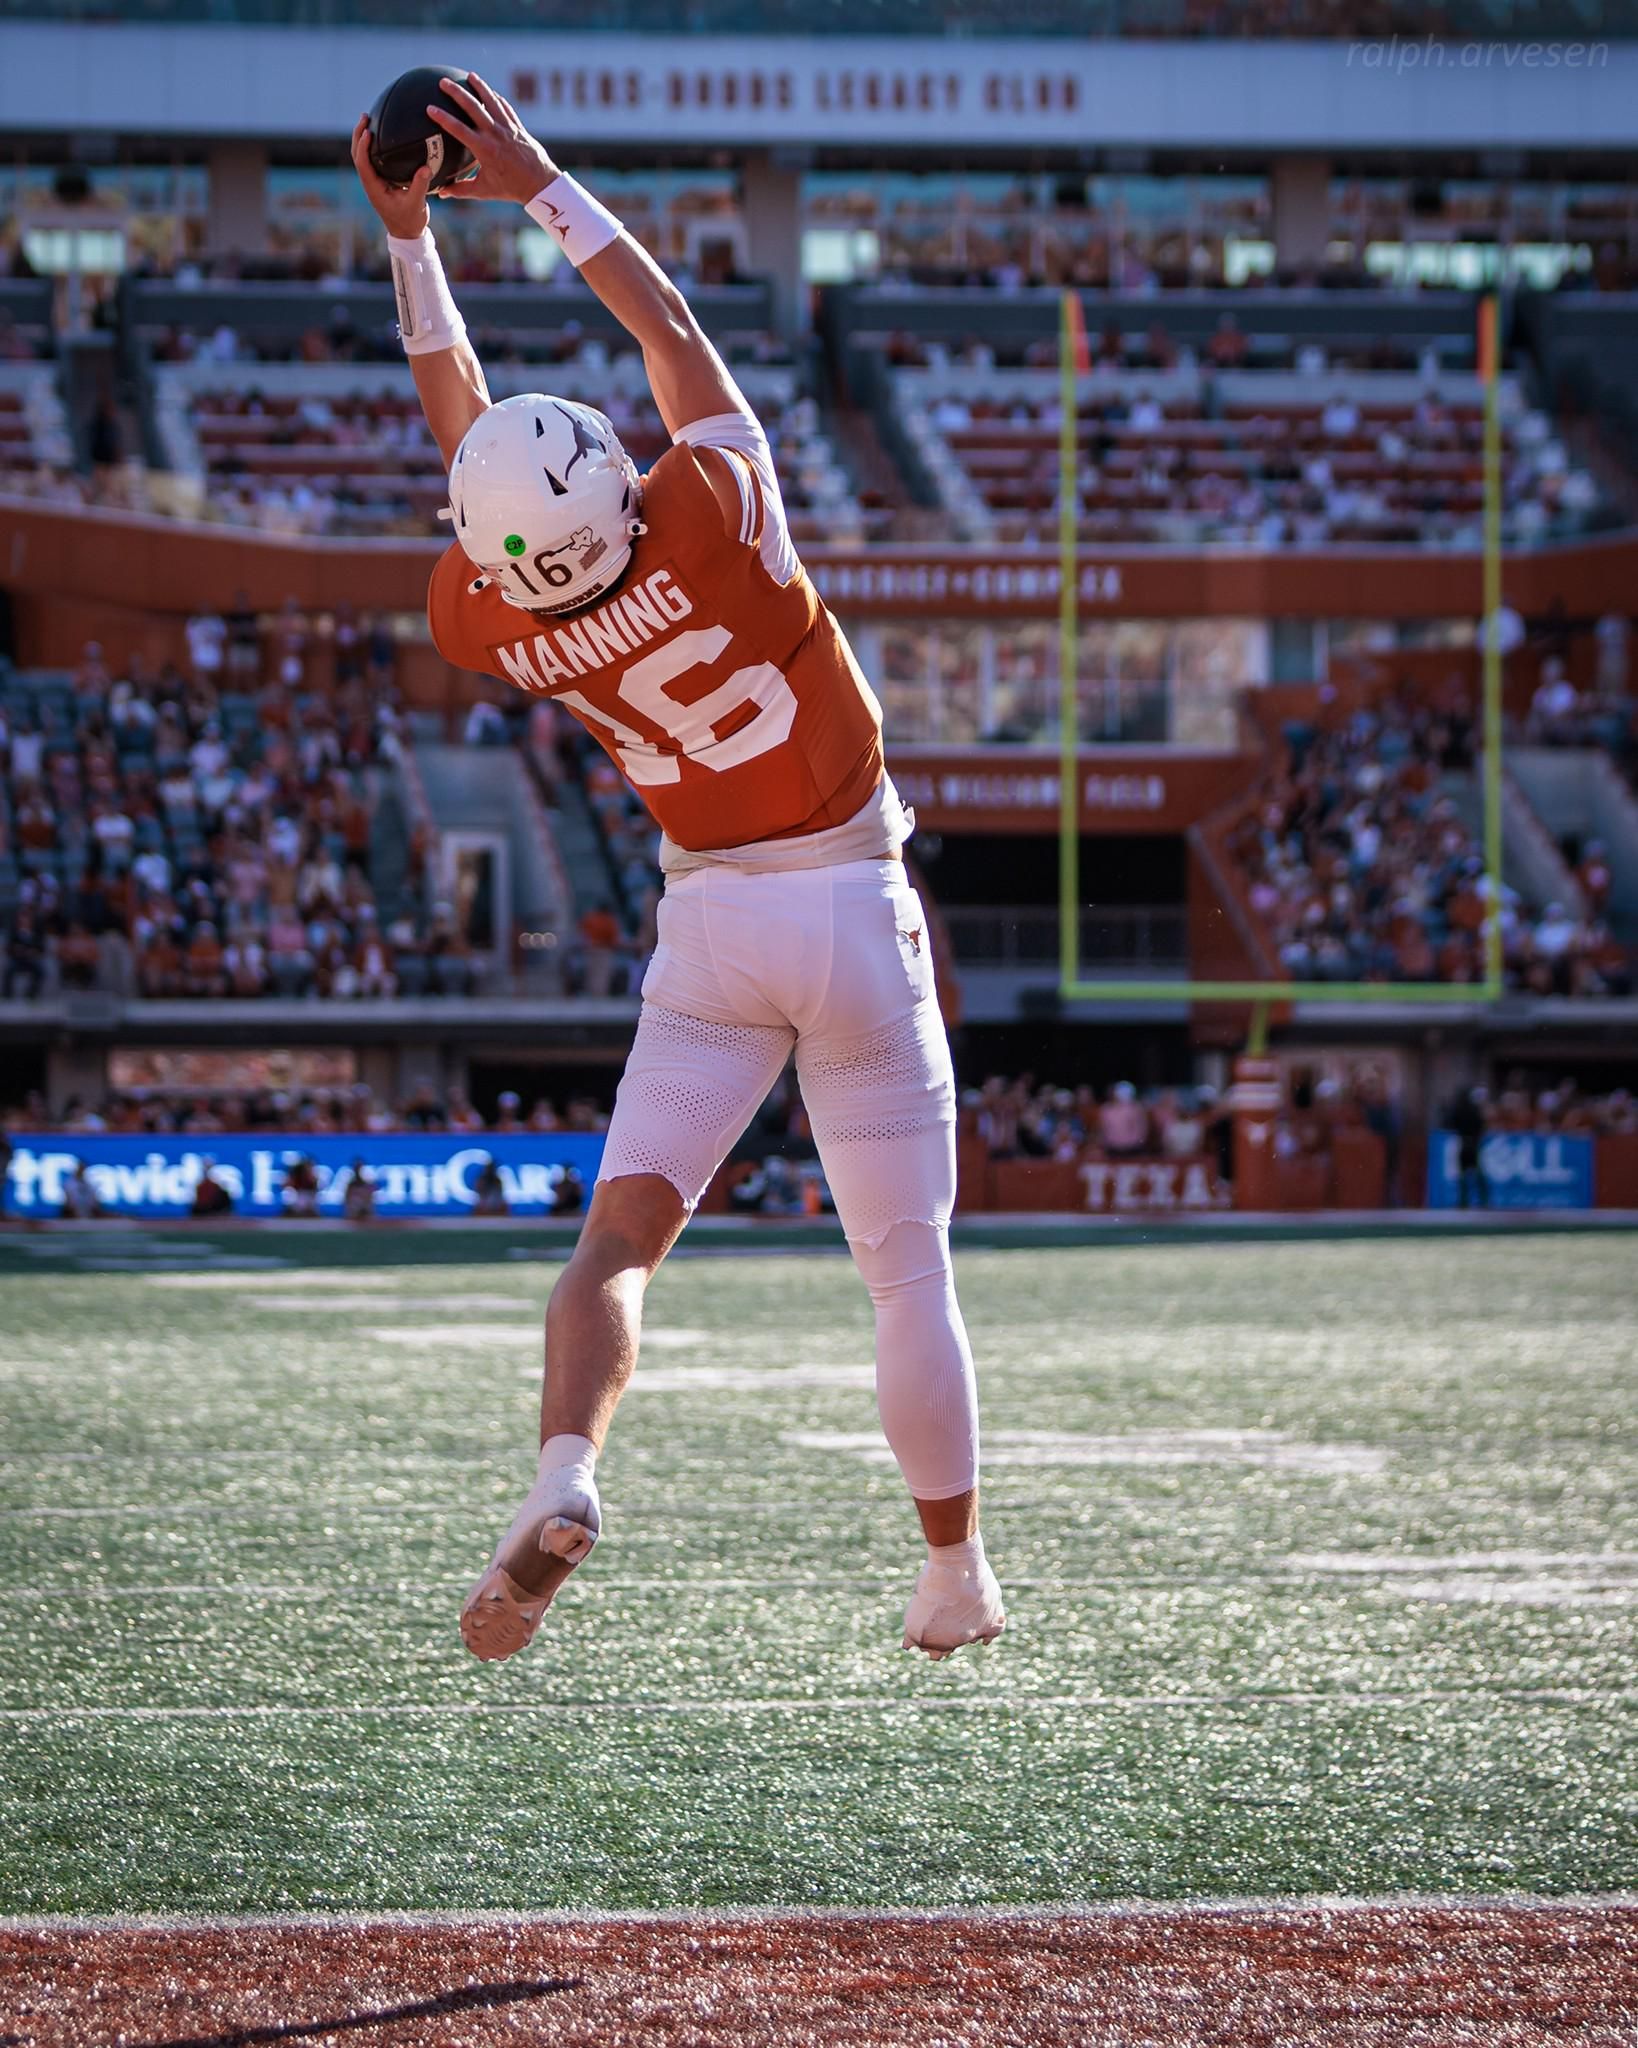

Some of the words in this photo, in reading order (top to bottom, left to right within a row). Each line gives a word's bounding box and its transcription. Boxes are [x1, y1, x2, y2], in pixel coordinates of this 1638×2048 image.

[813, 68, 962, 113] LEGACY
[505, 538, 524, 551] C2P
[510, 547, 573, 595] 16
[972, 564, 1122, 600] COMPEX
[497, 569, 693, 690] MANNING
[551, 624, 798, 785] 16
